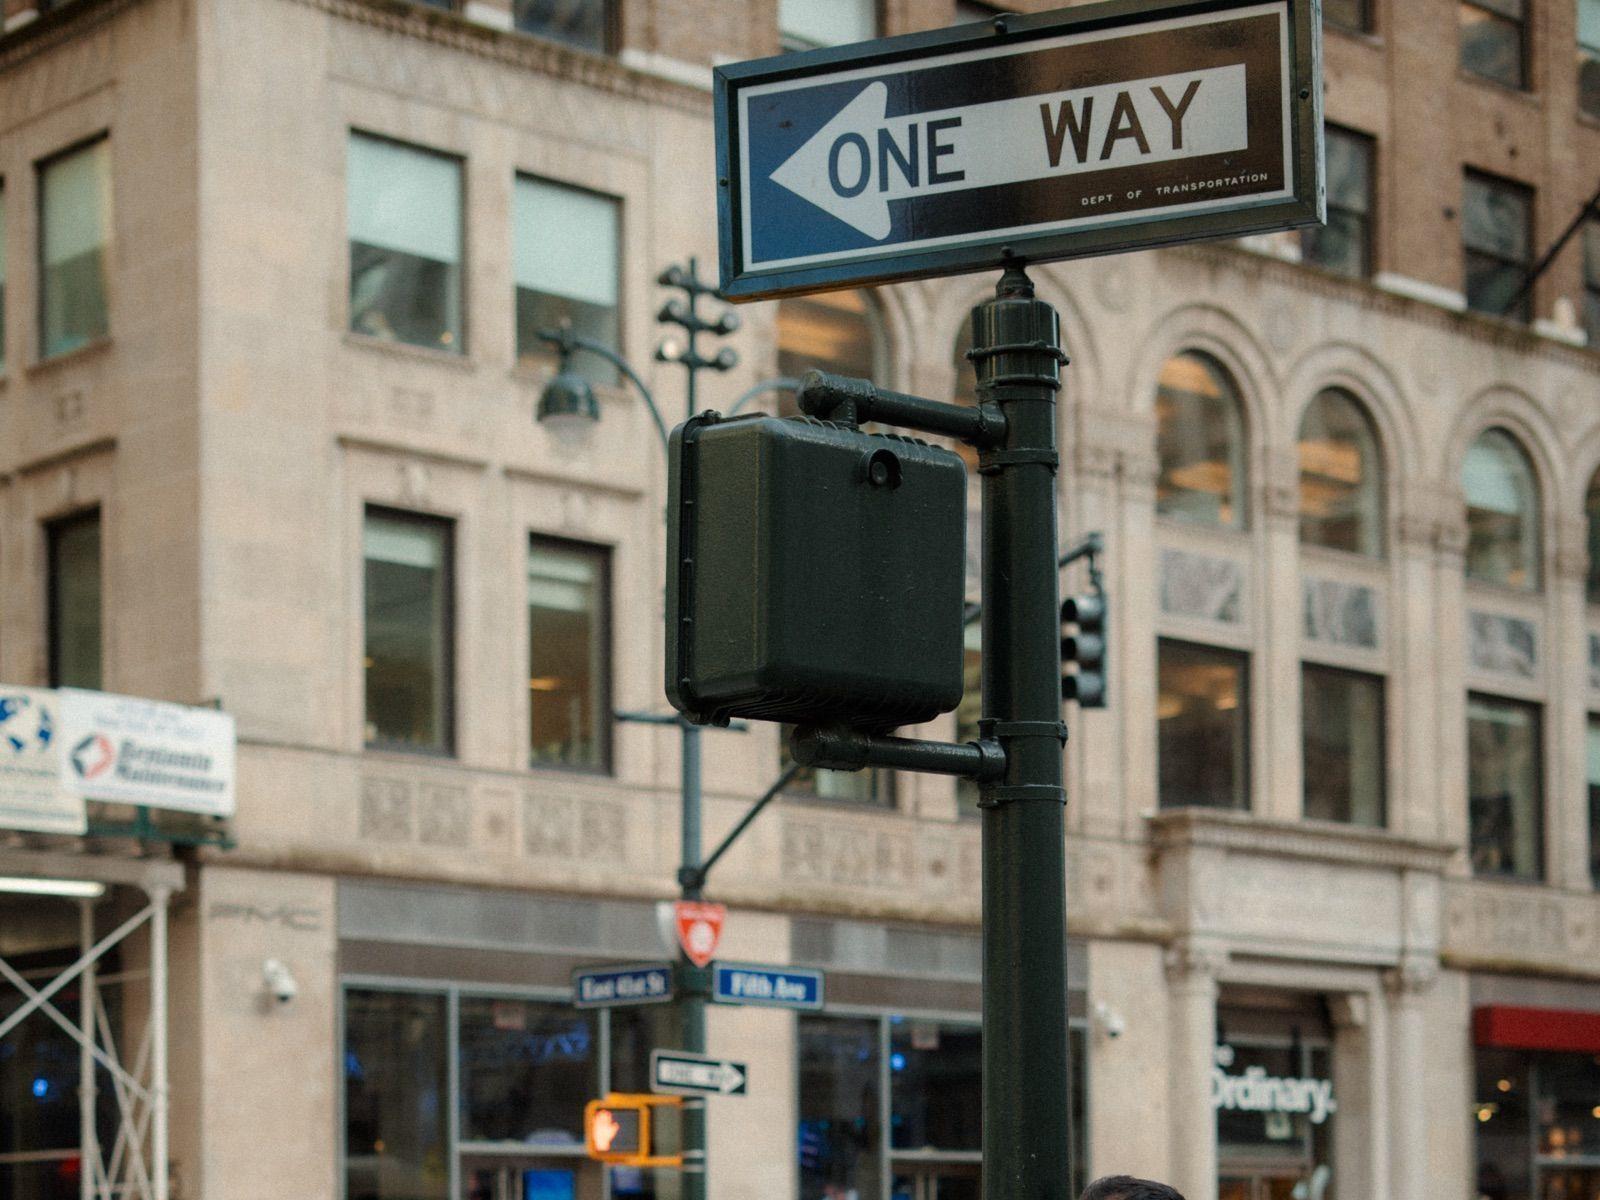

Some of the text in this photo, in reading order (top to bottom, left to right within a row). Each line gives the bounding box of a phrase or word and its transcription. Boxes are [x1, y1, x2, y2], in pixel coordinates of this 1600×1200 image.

[827, 79, 1203, 199] ONE WAY
[1081, 173, 1269, 206] DEPT OF TRANSPORTATION
